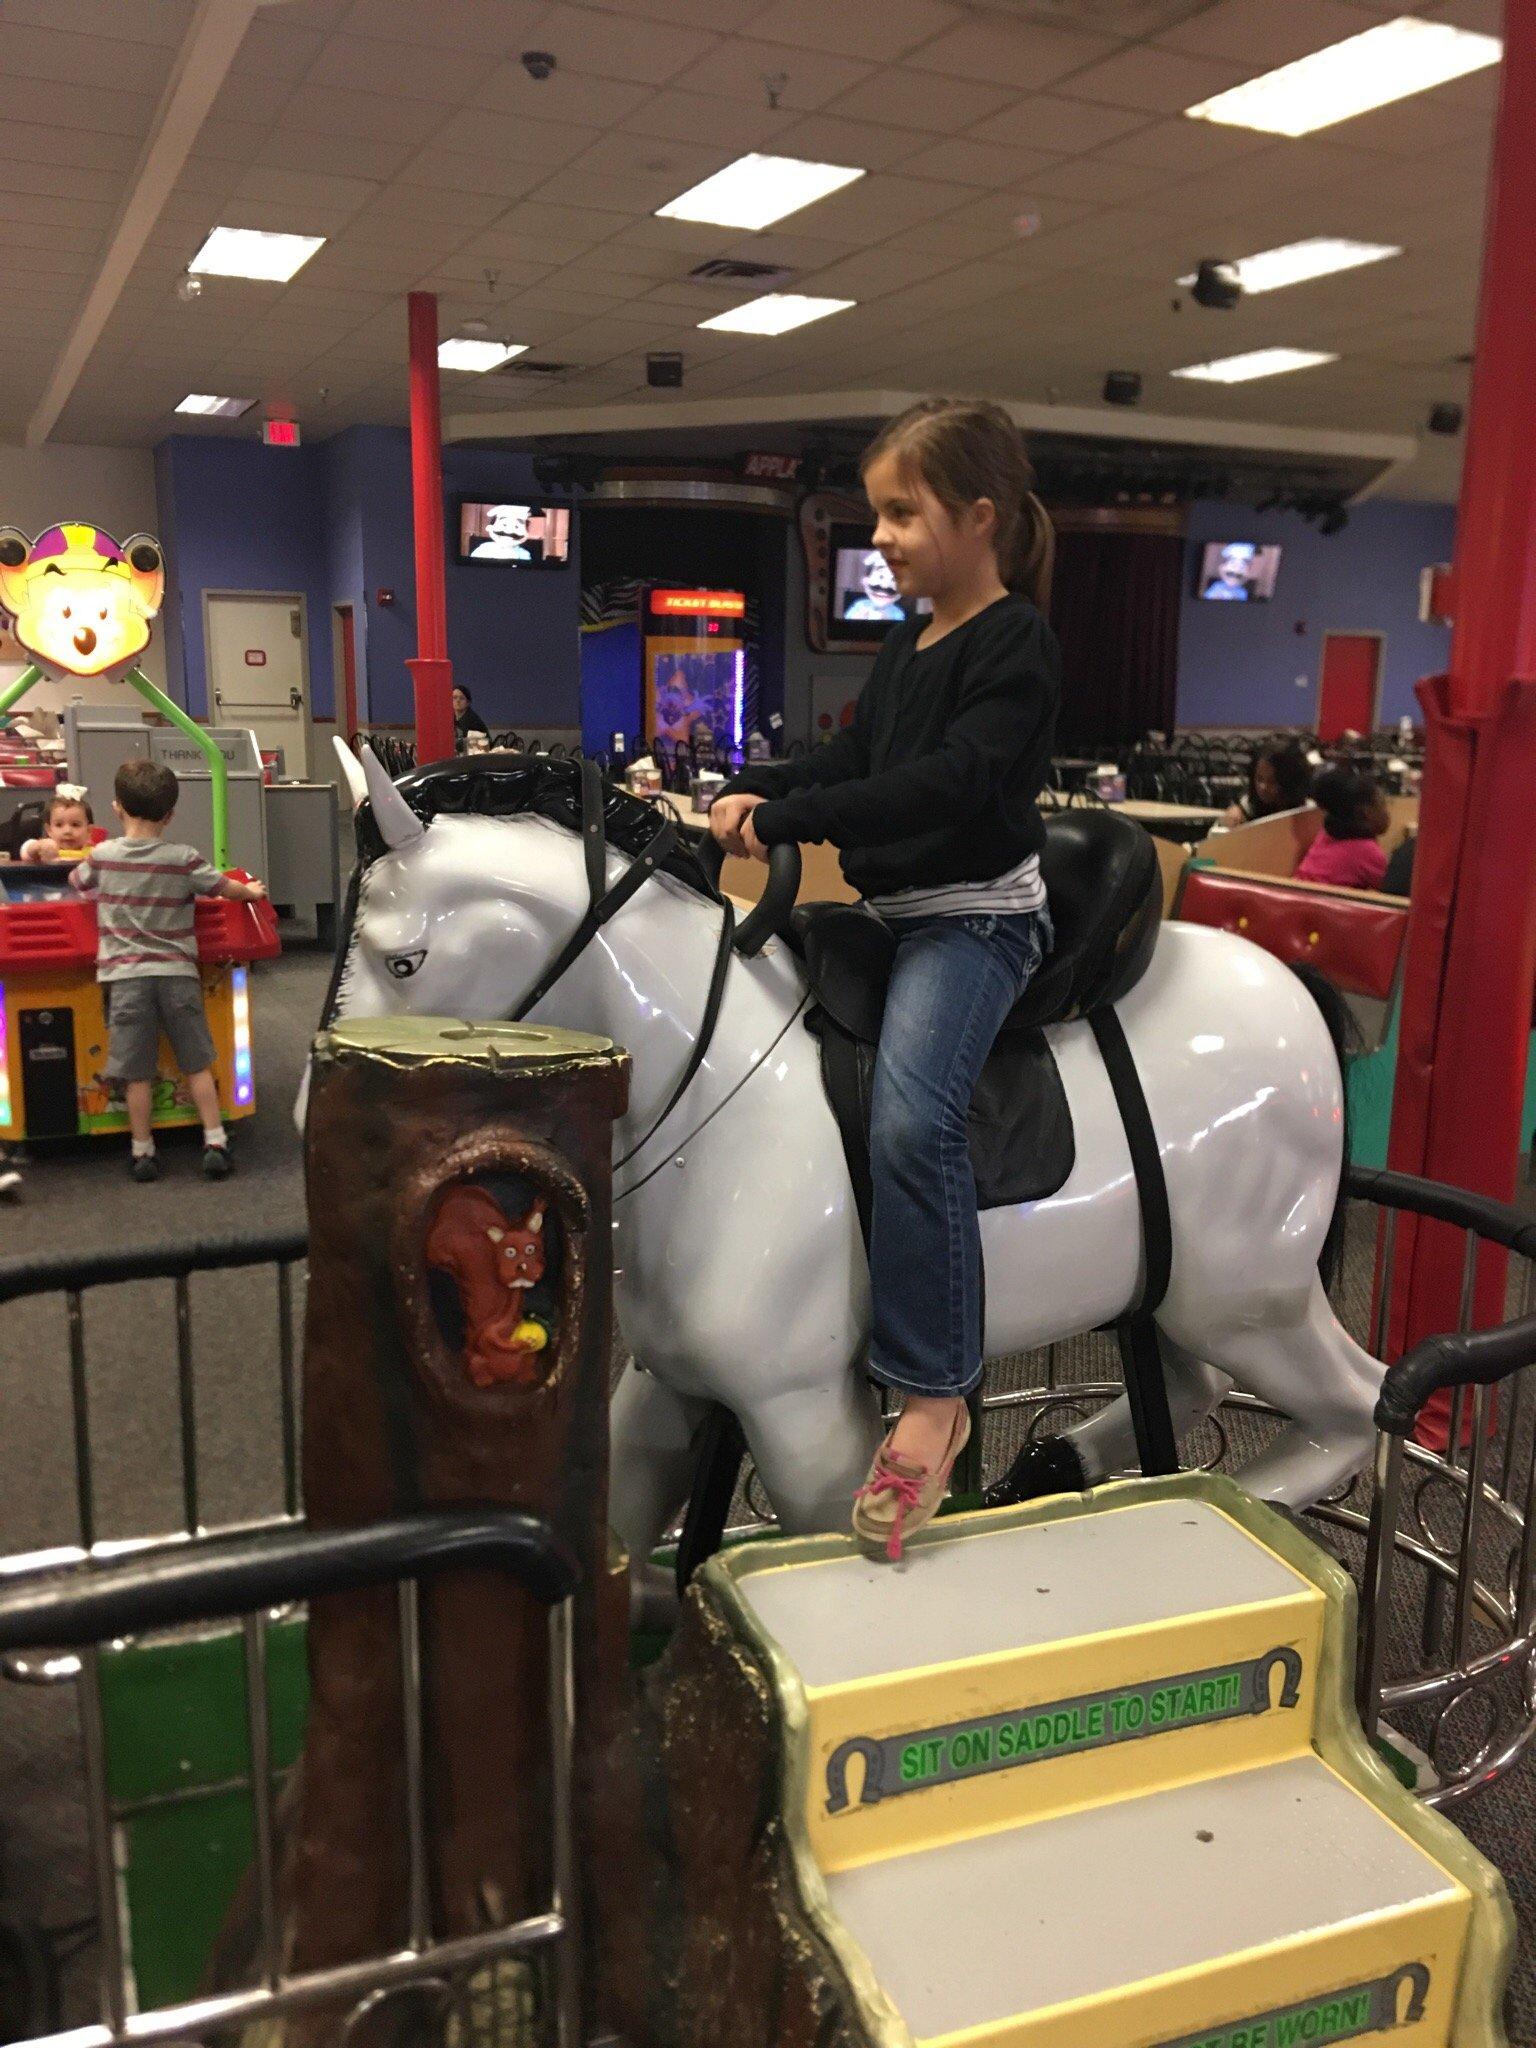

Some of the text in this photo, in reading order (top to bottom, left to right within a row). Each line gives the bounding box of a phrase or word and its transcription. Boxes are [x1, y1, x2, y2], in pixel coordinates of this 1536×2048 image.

[161, 749, 202, 760] THANK
[902, 1673, 1241, 1780] SIT ON SADDLE TO START!
[1274, 1993, 1371, 2048] WORN!
